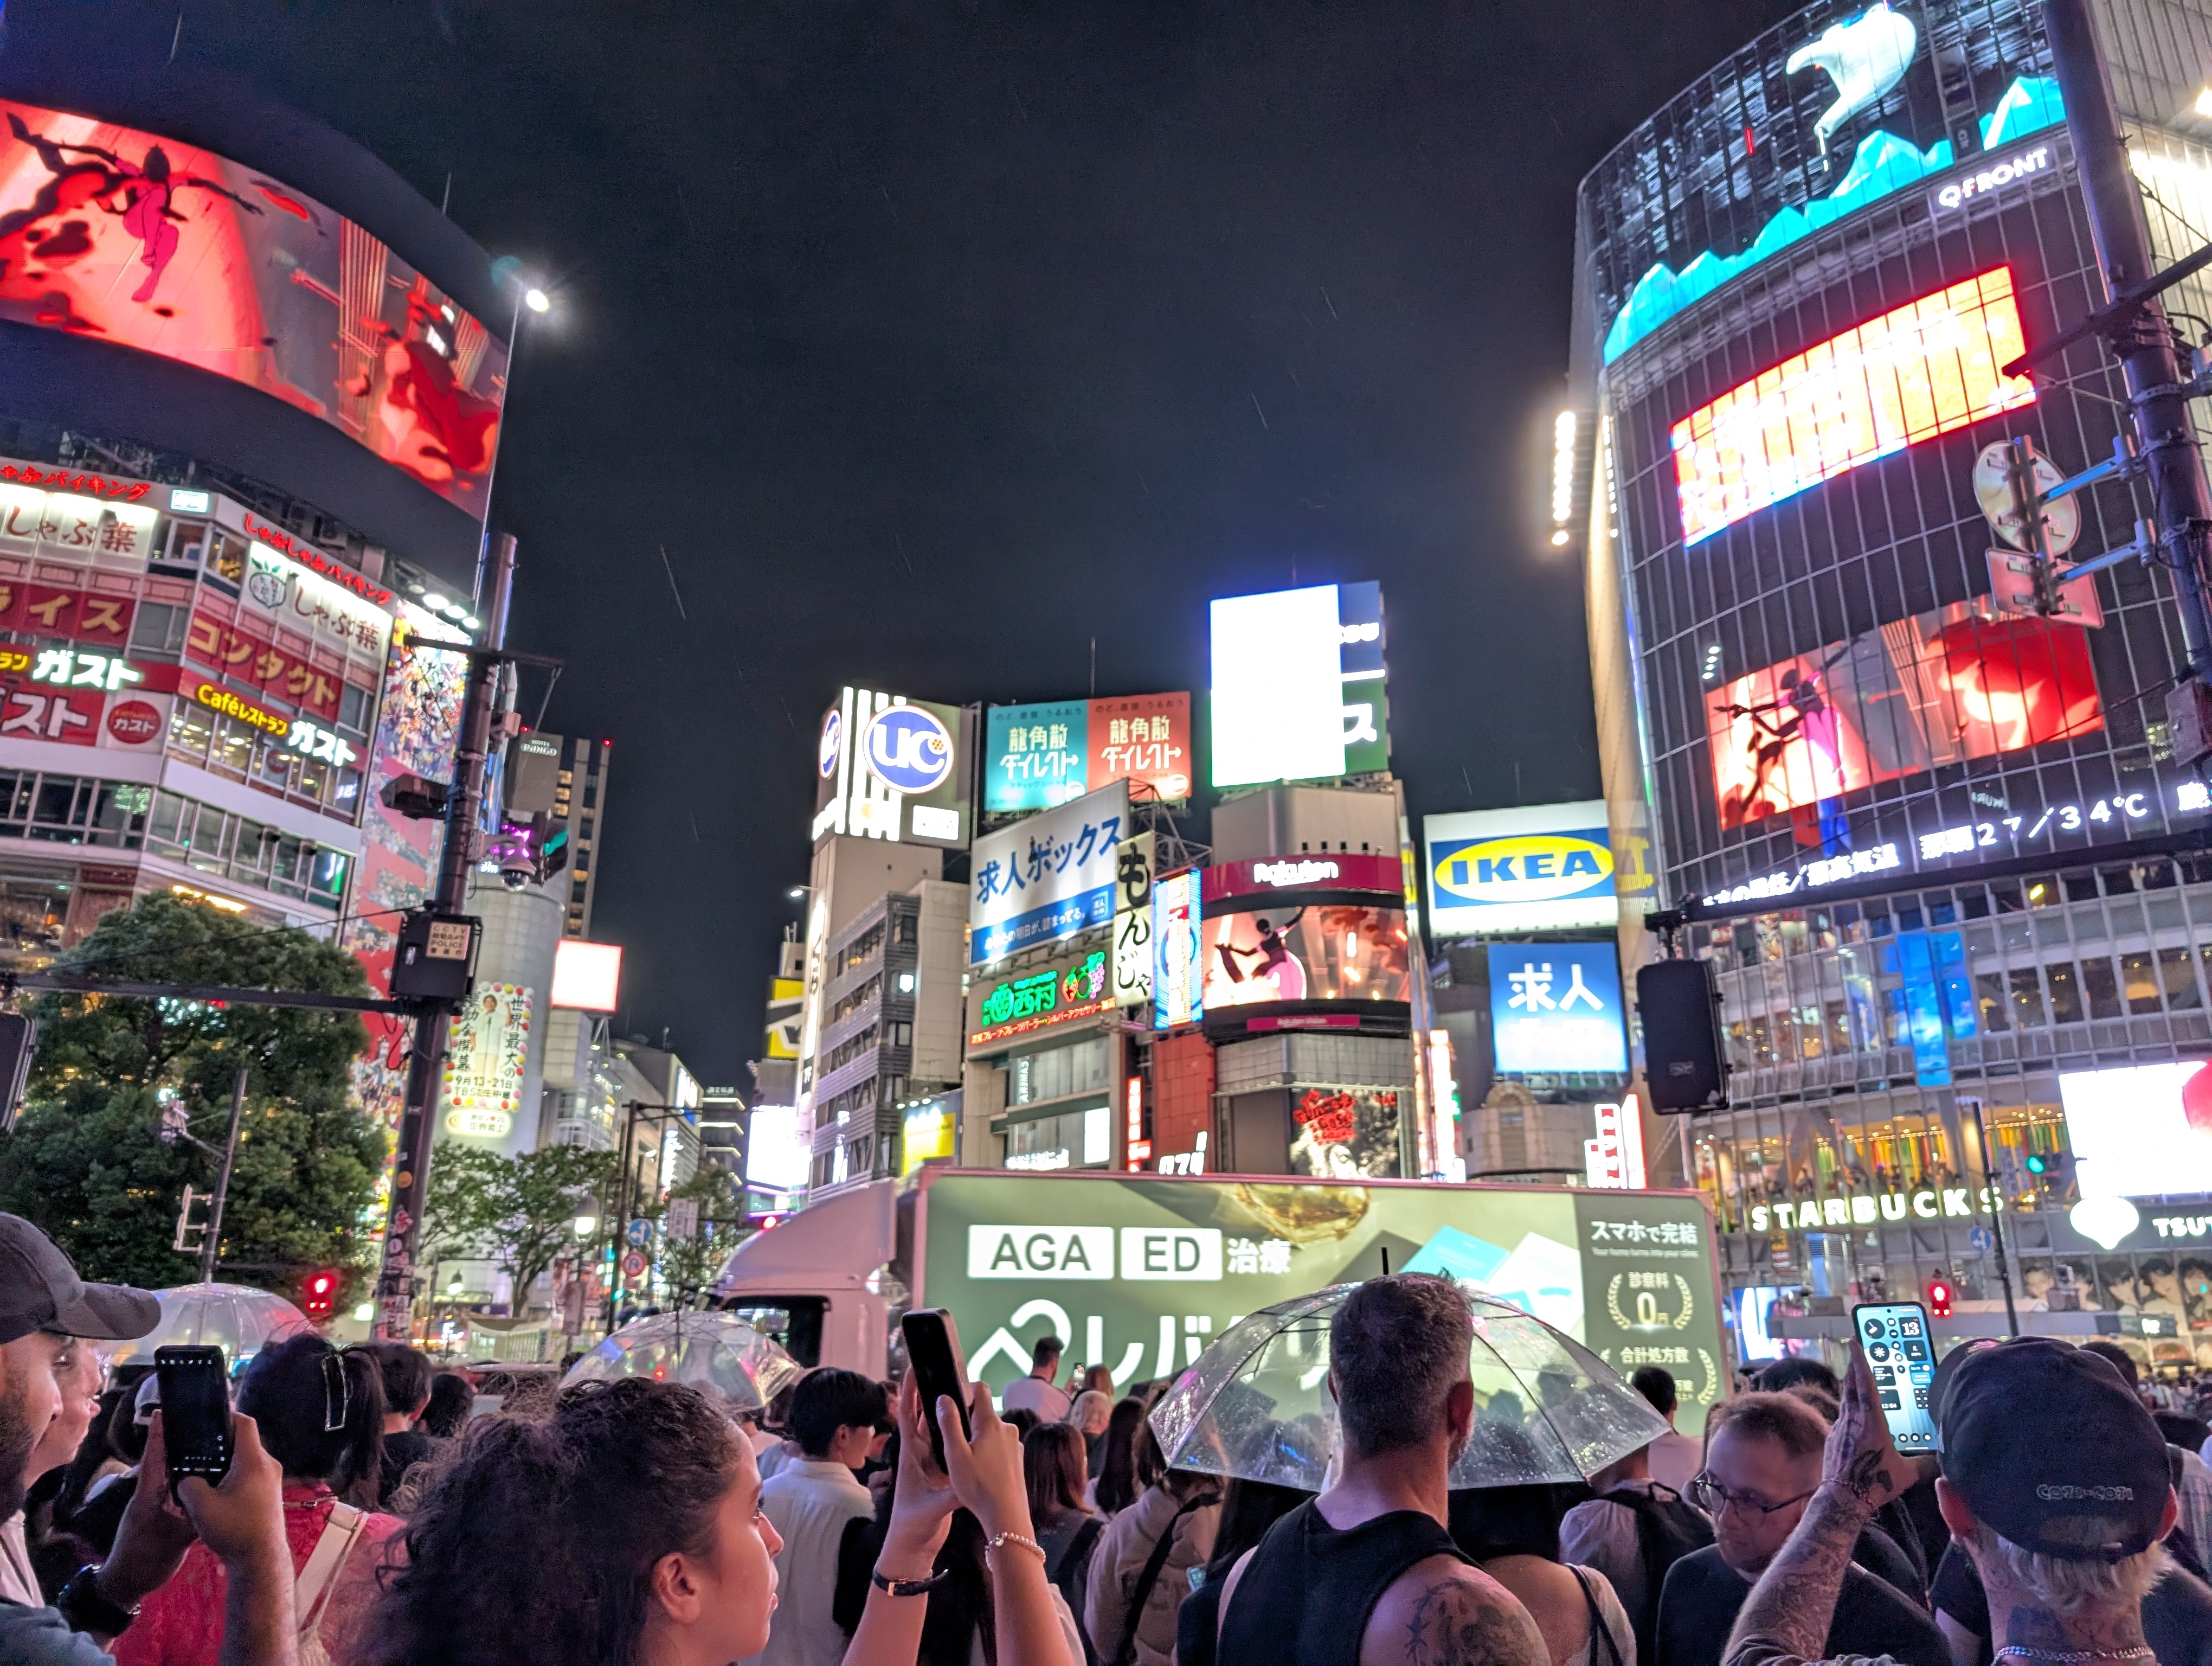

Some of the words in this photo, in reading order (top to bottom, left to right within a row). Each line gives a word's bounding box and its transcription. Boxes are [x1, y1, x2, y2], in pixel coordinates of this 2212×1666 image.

[6, 505, 137, 553] しゃぶ葉
[244, 512, 393, 605] しゃぶしゃぶバイキング
[294, 586, 380, 651] しゃぶ葉
[33, 649, 142, 690] ガスト
[189, 616, 337, 707] コンタクト
[0, 687, 88, 738] スト
[113, 717, 156, 734] ガスト
[1109, 714, 1171, 745] 龍角散
[288, 720, 356, 766] ガスト
[1008, 722, 1069, 753] 龍角散
[999, 750, 1079, 780] ダイレクト
[1101, 742, 1183, 773] ダイレクト
[976, 816, 1123, 904] 求人ボックス
[1253, 860, 1339, 888] Rakuten
[1451, 849, 1602, 885] IKEA
[1117, 842, 1152, 997] もんじゃ
[431, 939, 463, 948] POLICE
[1013, 982, 1058, 1018] 西村
[1507, 962, 1605, 1013] 求人
[504, 996, 525, 1079] 世界最大の
[1751, 1186, 2004, 1231] STARBUCKS
[1590, 1220, 1699, 1245] スマホで完結
[990, 1232, 1091, 1271] AGA
[1143, 1236, 1202, 1272] ED
[1227, 1238, 1292, 1274] 治療
[1628, 1271, 1670, 1290] 診察料
[1901, 1321, 1920, 1335] 13
[1619, 1346, 1690, 1365] 合計処方数
